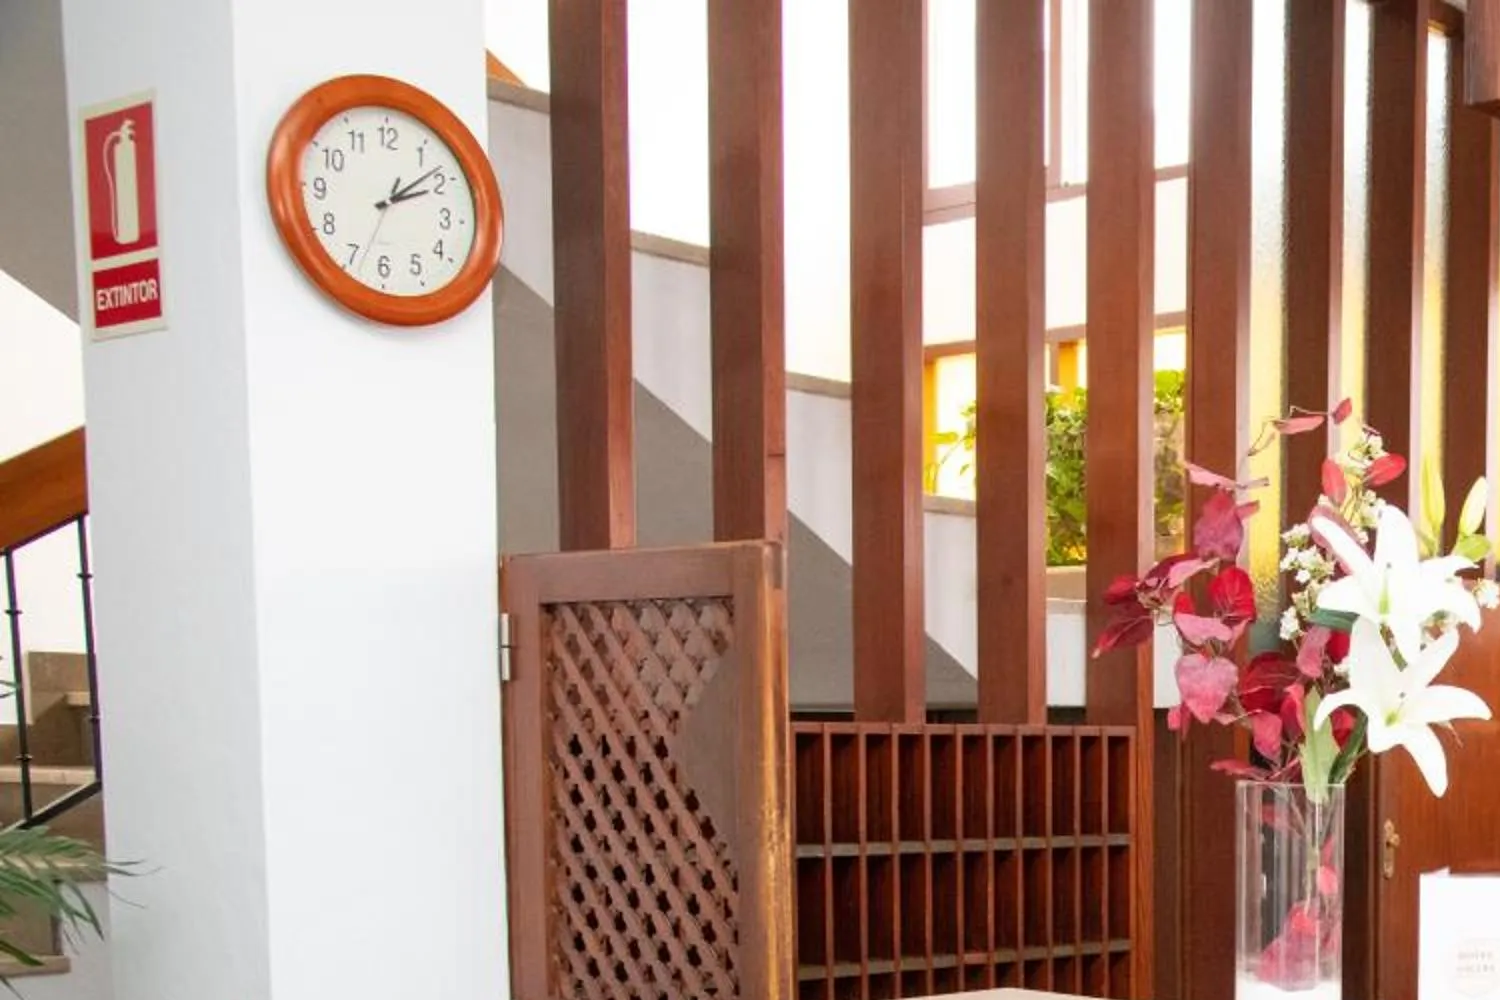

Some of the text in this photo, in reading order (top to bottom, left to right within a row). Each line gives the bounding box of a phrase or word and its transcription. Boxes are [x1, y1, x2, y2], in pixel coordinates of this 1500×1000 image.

[348, 129, 365, 153] 11
[377, 125, 399, 151] 12
[322, 148, 345, 172] 10
[416, 146, 424, 167] 1
[313, 177, 327, 200] 9
[433, 172, 446, 195] 2
[322, 212, 336, 235] 8
[439, 207, 451, 230] 3
[346, 243, 360, 265] 7
[431, 239, 444, 261] 4
[377, 255, 391, 278] 6
[409, 253, 422, 276] 5
[97, 278, 159, 311] EXTINTOR
